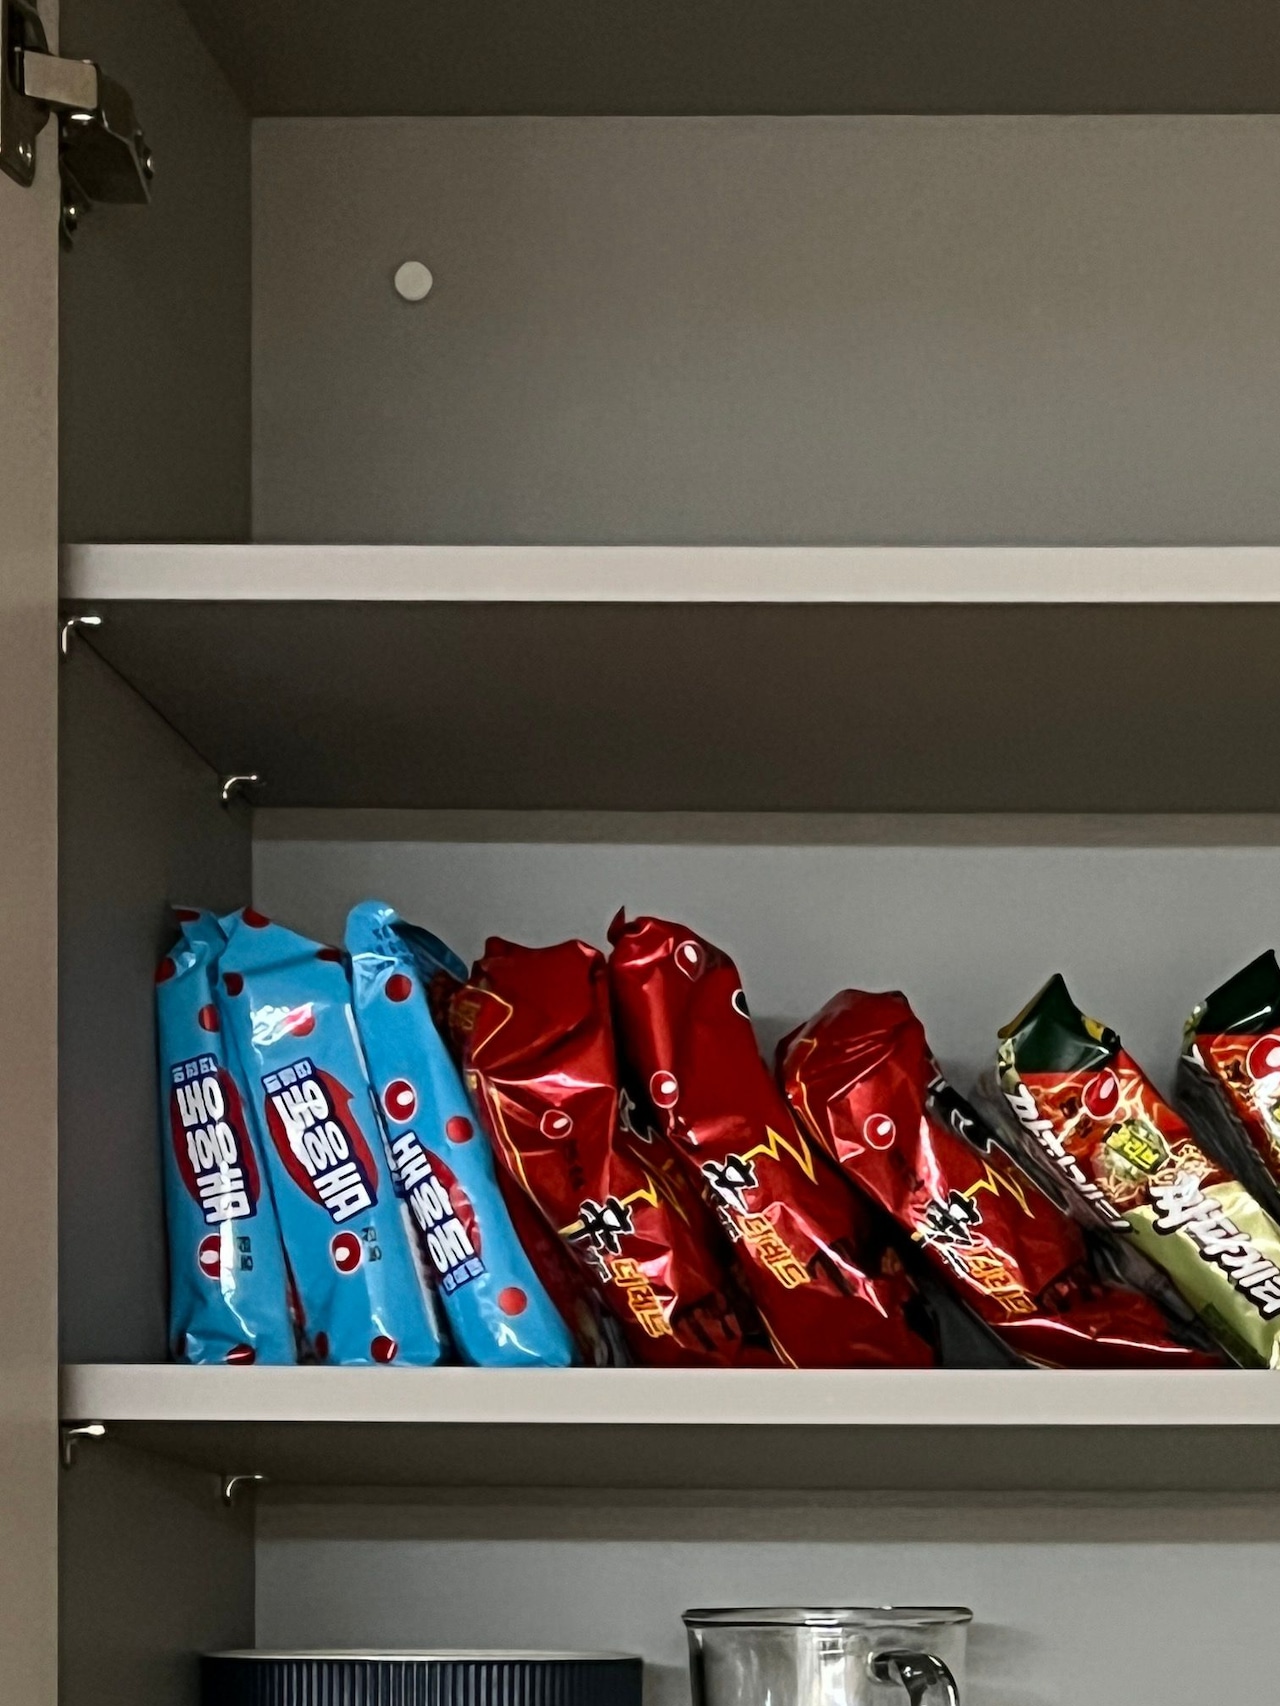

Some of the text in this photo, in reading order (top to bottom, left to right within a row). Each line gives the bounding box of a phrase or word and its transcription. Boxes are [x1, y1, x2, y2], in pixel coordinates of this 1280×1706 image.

[177, 1078, 251, 1223] 배홍동
[272, 1079, 371, 1223] 배홍동
[390, 1131, 474, 1274] 배홍동
